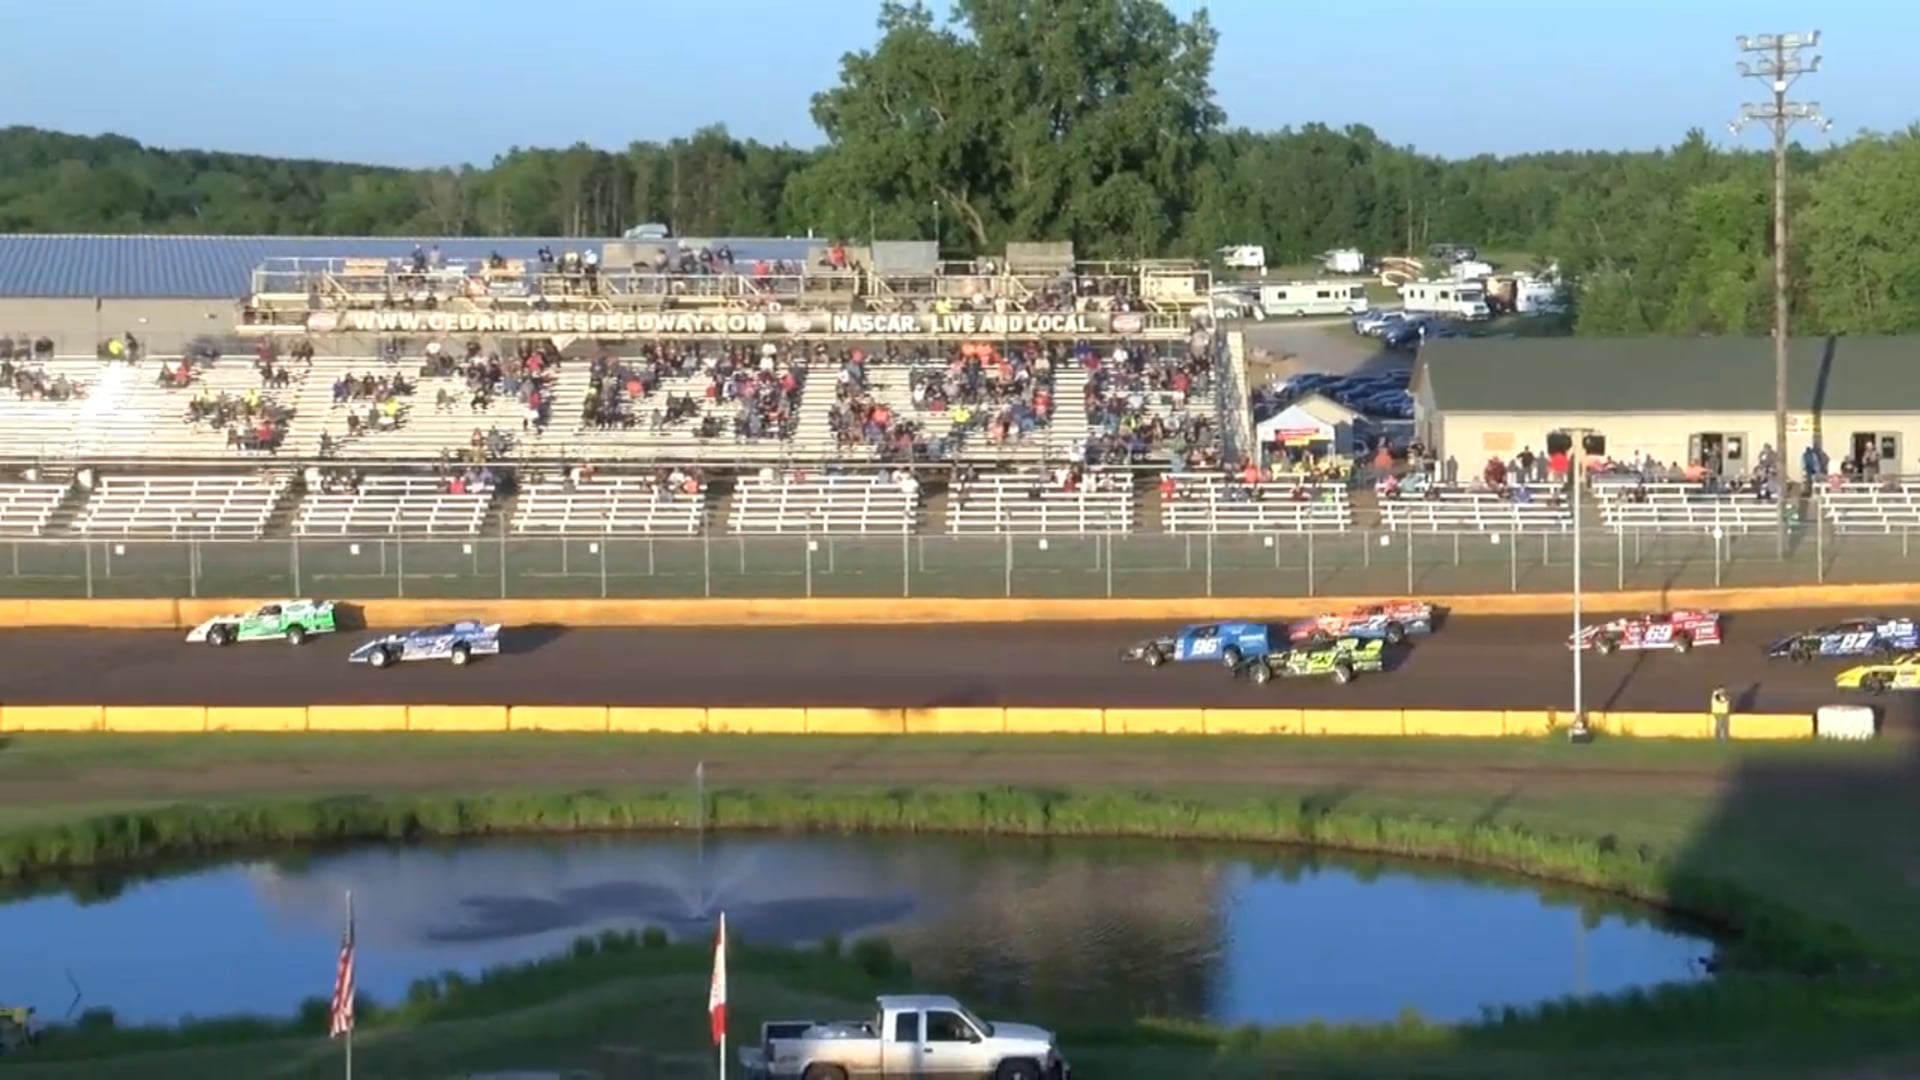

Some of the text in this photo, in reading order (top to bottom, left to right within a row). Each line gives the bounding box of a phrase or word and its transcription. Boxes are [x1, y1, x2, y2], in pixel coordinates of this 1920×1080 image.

[353, 313, 766, 330] WWW.CEDARLAKESPEEDWAY.COM
[931, 313, 975, 332] LIVE
[980, 313, 1027, 332] AND
[1645, 623, 1673, 642] 69
[1840, 632, 1874, 649] 87
[1192, 639, 1218, 654] 96
